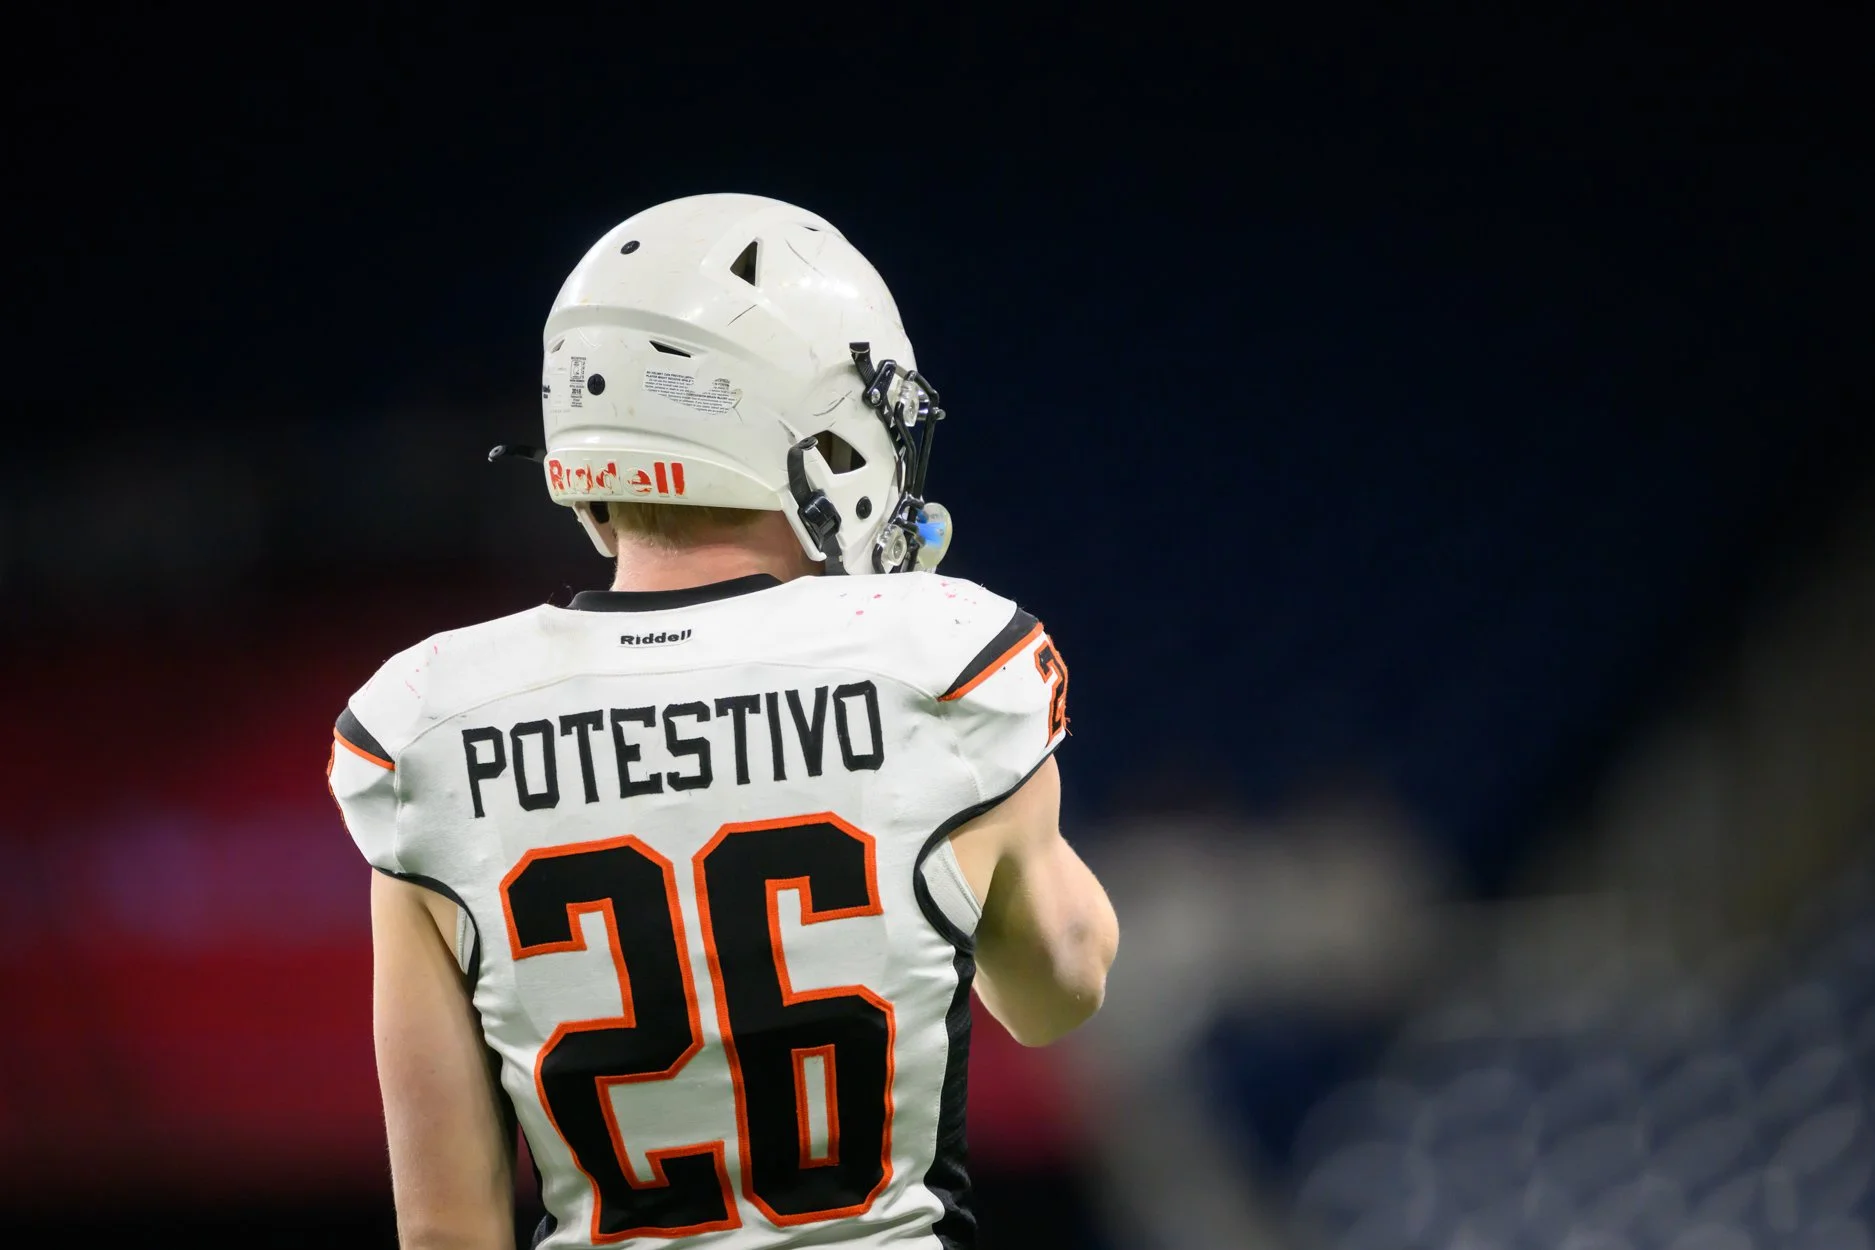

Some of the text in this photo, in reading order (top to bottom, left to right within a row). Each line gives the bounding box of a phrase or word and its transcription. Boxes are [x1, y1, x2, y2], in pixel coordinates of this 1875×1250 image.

[620, 628, 692, 645] Riddell
[461, 680, 884, 818] POTESTIVO
[499, 811, 895, 1245] 26
